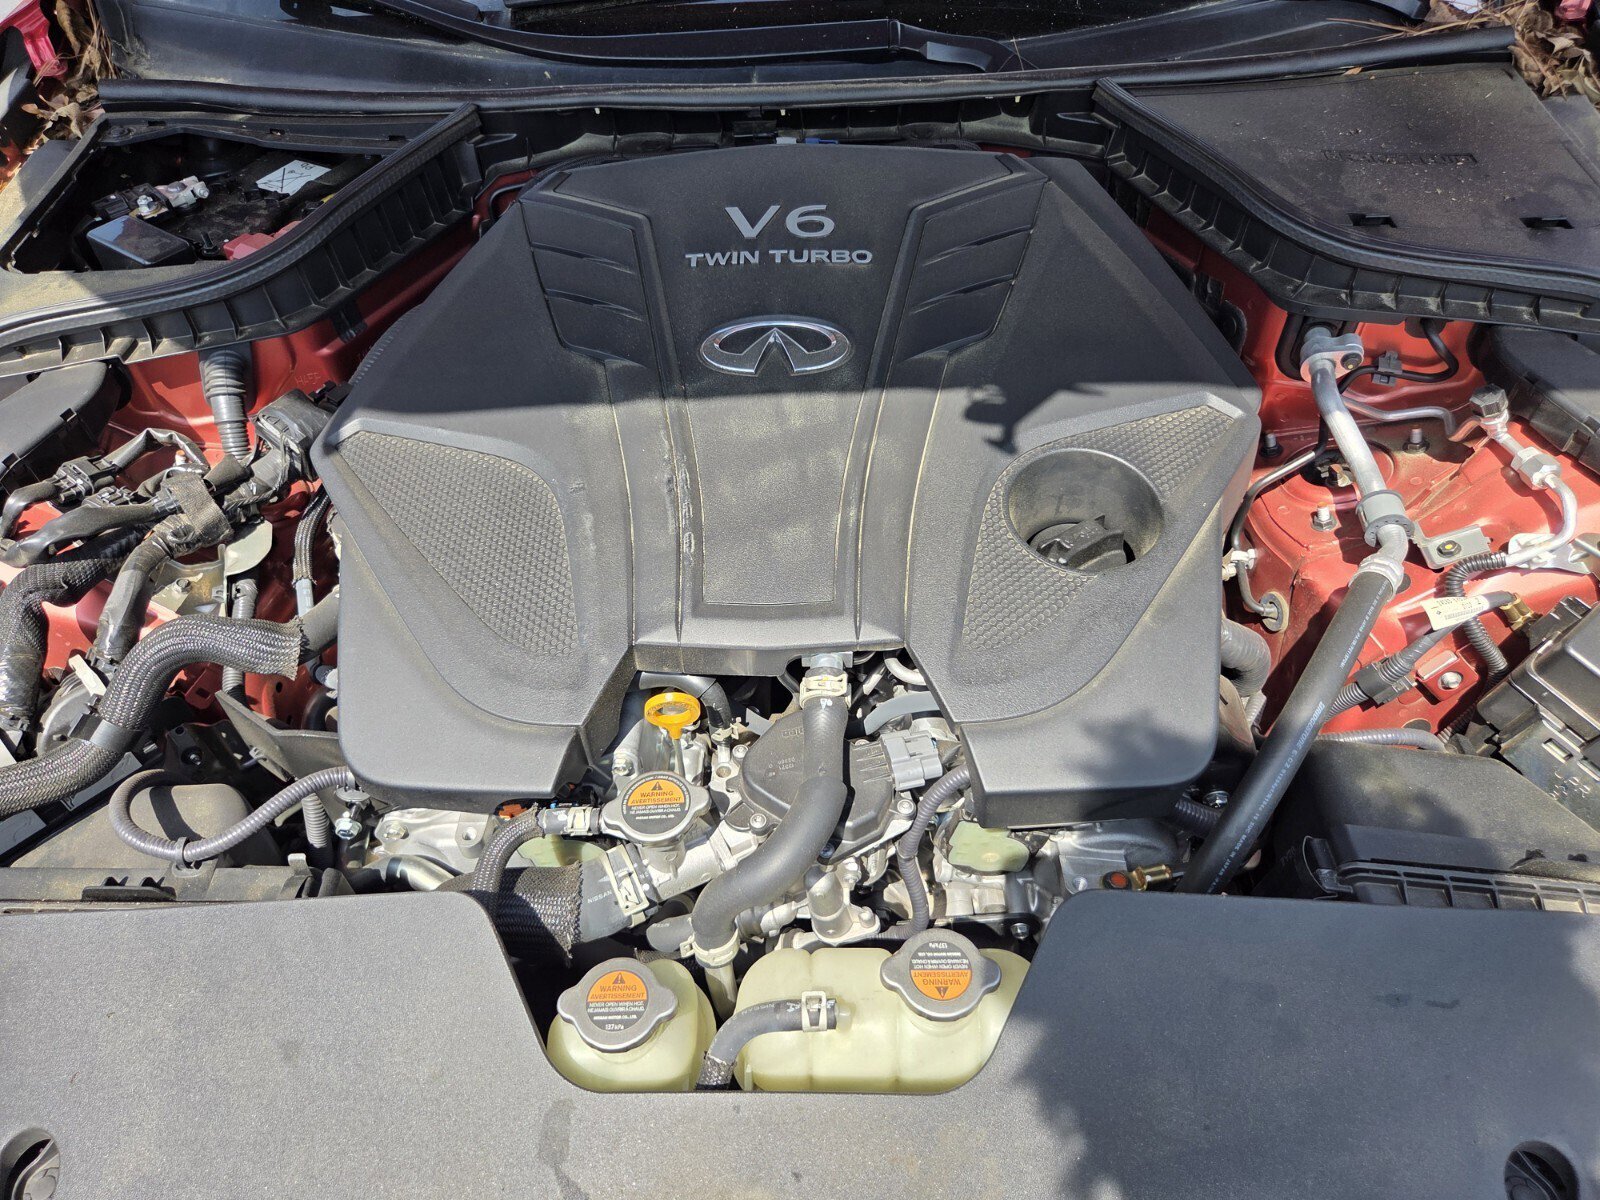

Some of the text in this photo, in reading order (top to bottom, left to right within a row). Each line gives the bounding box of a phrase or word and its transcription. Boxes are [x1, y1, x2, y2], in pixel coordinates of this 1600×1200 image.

[725, 205, 835, 239] V6
[685, 249, 873, 267] TWIN TURBO
[587, 889, 613, 904] NISSAN
